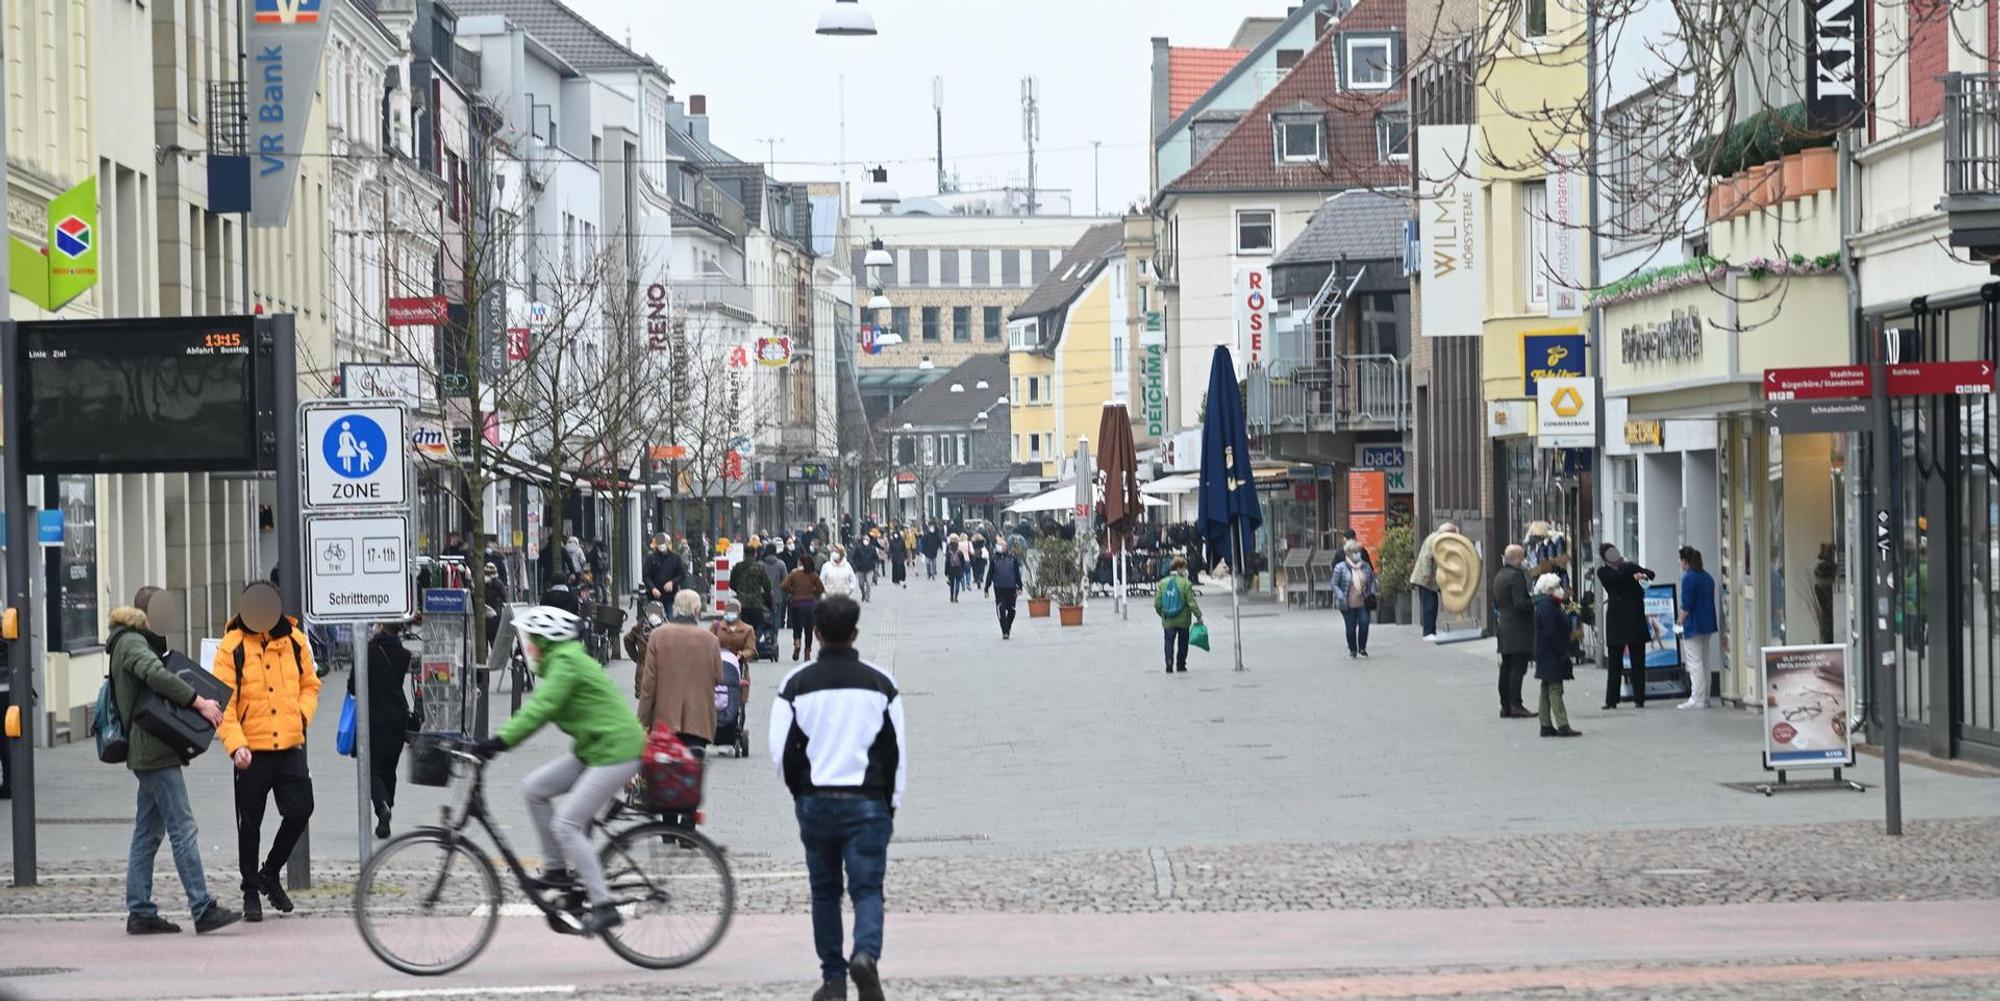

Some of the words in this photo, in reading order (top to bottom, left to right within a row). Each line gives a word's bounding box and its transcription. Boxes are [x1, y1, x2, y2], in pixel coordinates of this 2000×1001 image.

[256, 44, 284, 122] Bank
[260, 133, 285, 177] VR
[1433, 183, 1457, 279] WILMS
[1463, 191, 1474, 270] HÖRSYSTEME
[647, 283, 667, 350] RENO
[204, 334, 240, 347] 13:15
[29, 350, 47, 358] Linie
[53, 350, 67, 358] Ziel
[186, 346, 214, 355] Abfahrt
[1830, 370, 1864, 378] Stadthaus
[1892, 368, 1920, 376] Rathaus
[1544, 420, 1590, 428] COMMERZBANK
[413, 427, 442, 443] dm
[1364, 448, 1403, 467] back
[332, 482, 381, 499] ZONE
[367, 547, 376, 562] 17
[328, 562, 342, 571] frei
[329, 592, 390, 607] Schritttempo
